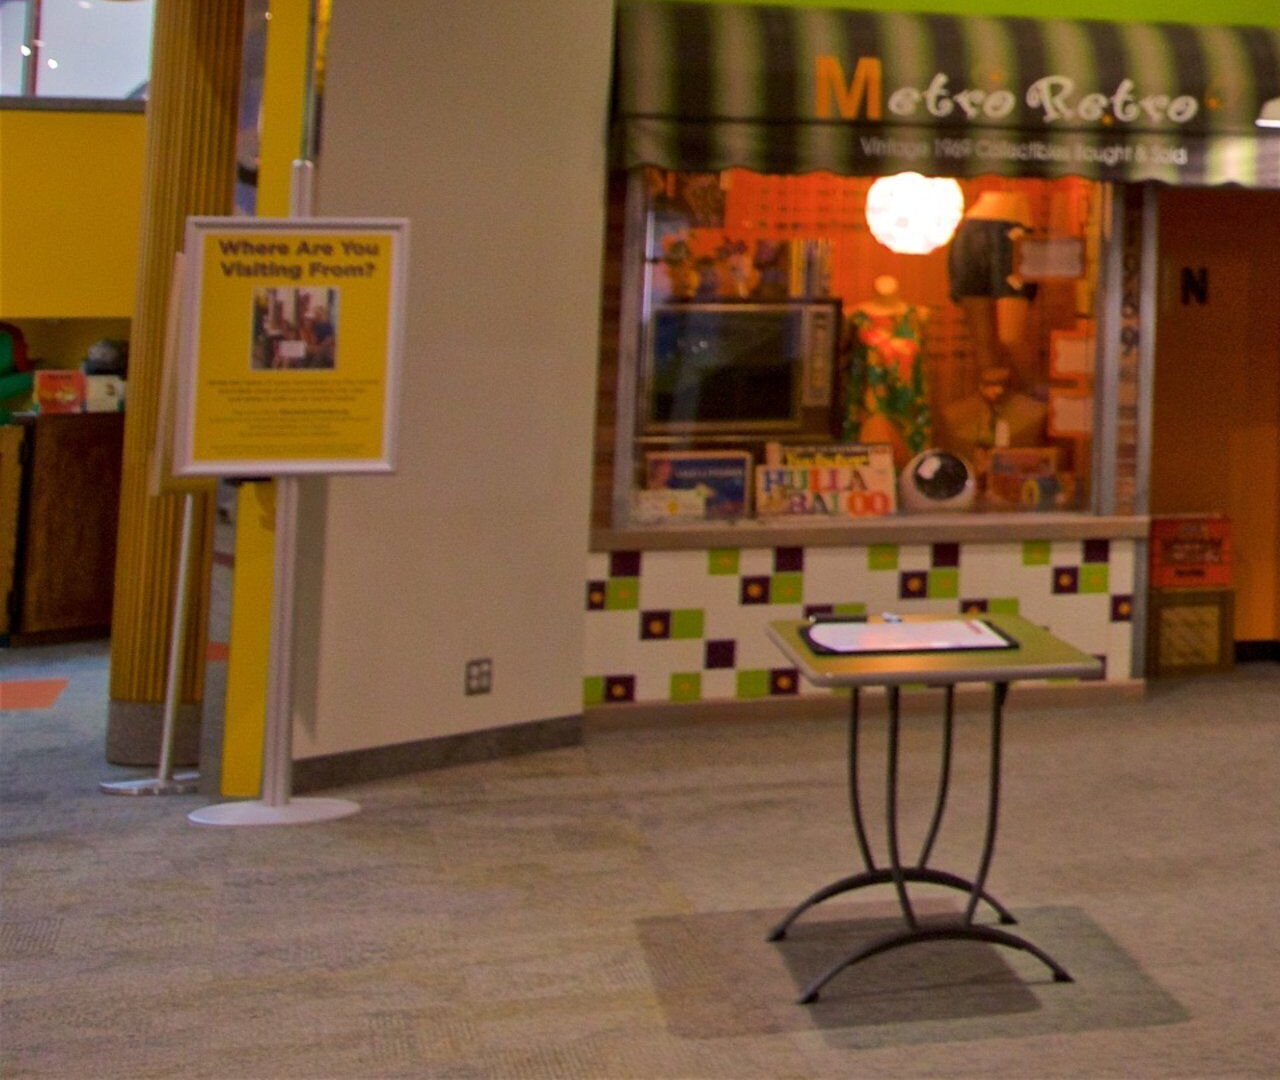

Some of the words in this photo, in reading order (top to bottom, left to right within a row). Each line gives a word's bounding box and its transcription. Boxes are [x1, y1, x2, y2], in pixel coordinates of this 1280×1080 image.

[814, 56, 1016, 121] Metro
[1025, 74, 1199, 122] Retro
[860, 136, 928, 161] Vintage
[1153, 146, 1188, 165] Sold
[219, 239, 289, 257] Where
[296, 240, 334, 257] Are
[341, 240, 380, 257] You
[220, 261, 303, 281] Visiting
[308, 261, 377, 279] From?
